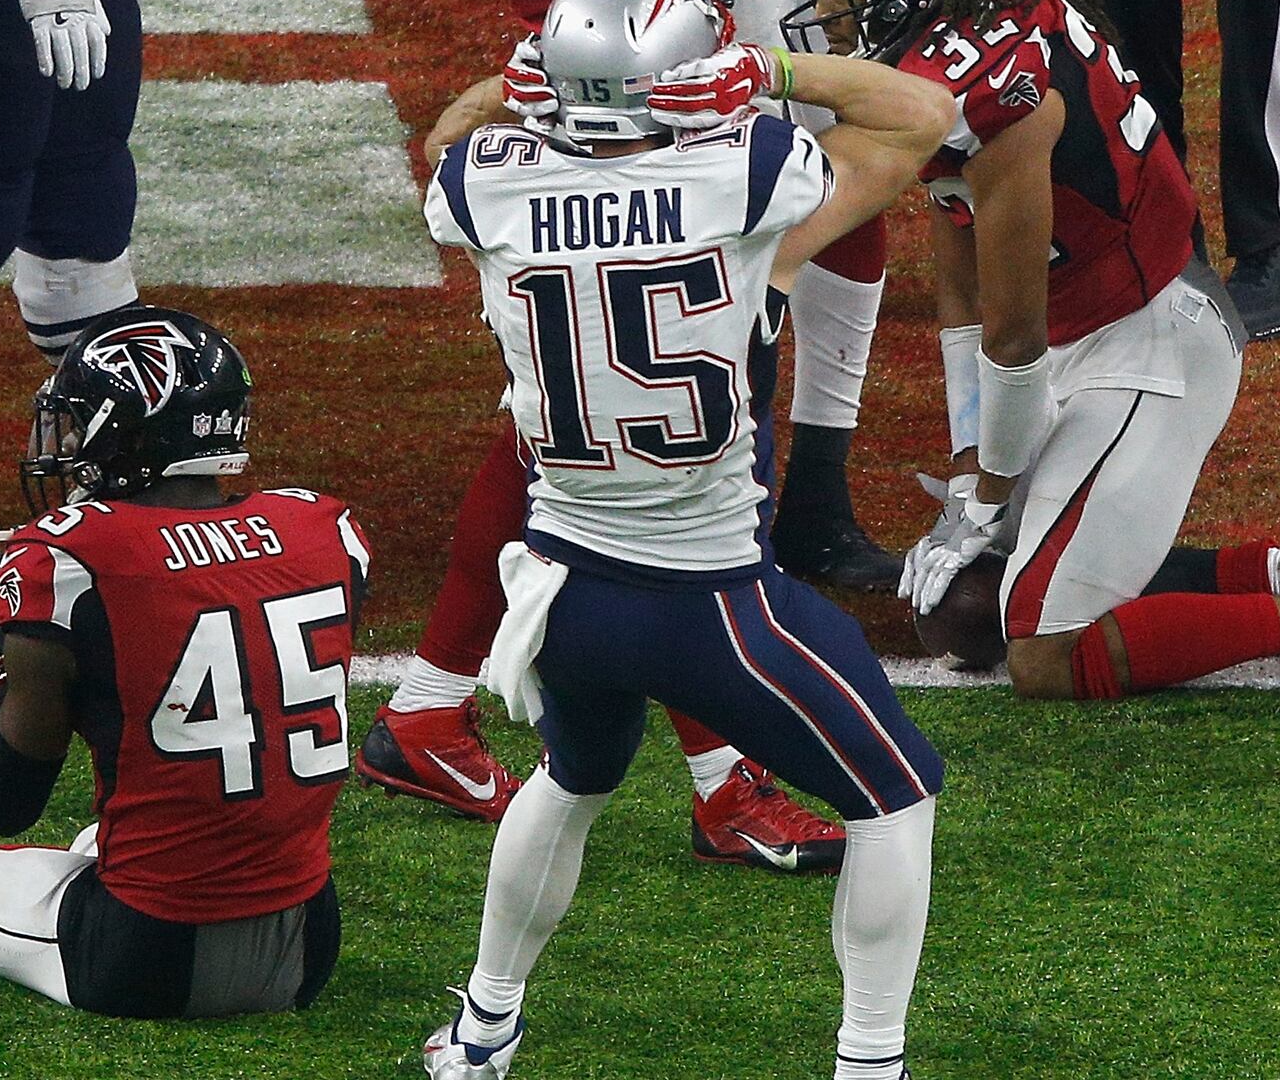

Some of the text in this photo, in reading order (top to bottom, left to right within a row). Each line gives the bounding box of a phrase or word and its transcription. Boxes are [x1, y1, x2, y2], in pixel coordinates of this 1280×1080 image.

[578, 78, 611, 102] 15
[529, 187, 687, 254] HOGAN
[507, 247, 742, 472] 15
[219, 461, 251, 470] FALC
[159, 515, 283, 571] JONES
[151, 583, 351, 796] 45
